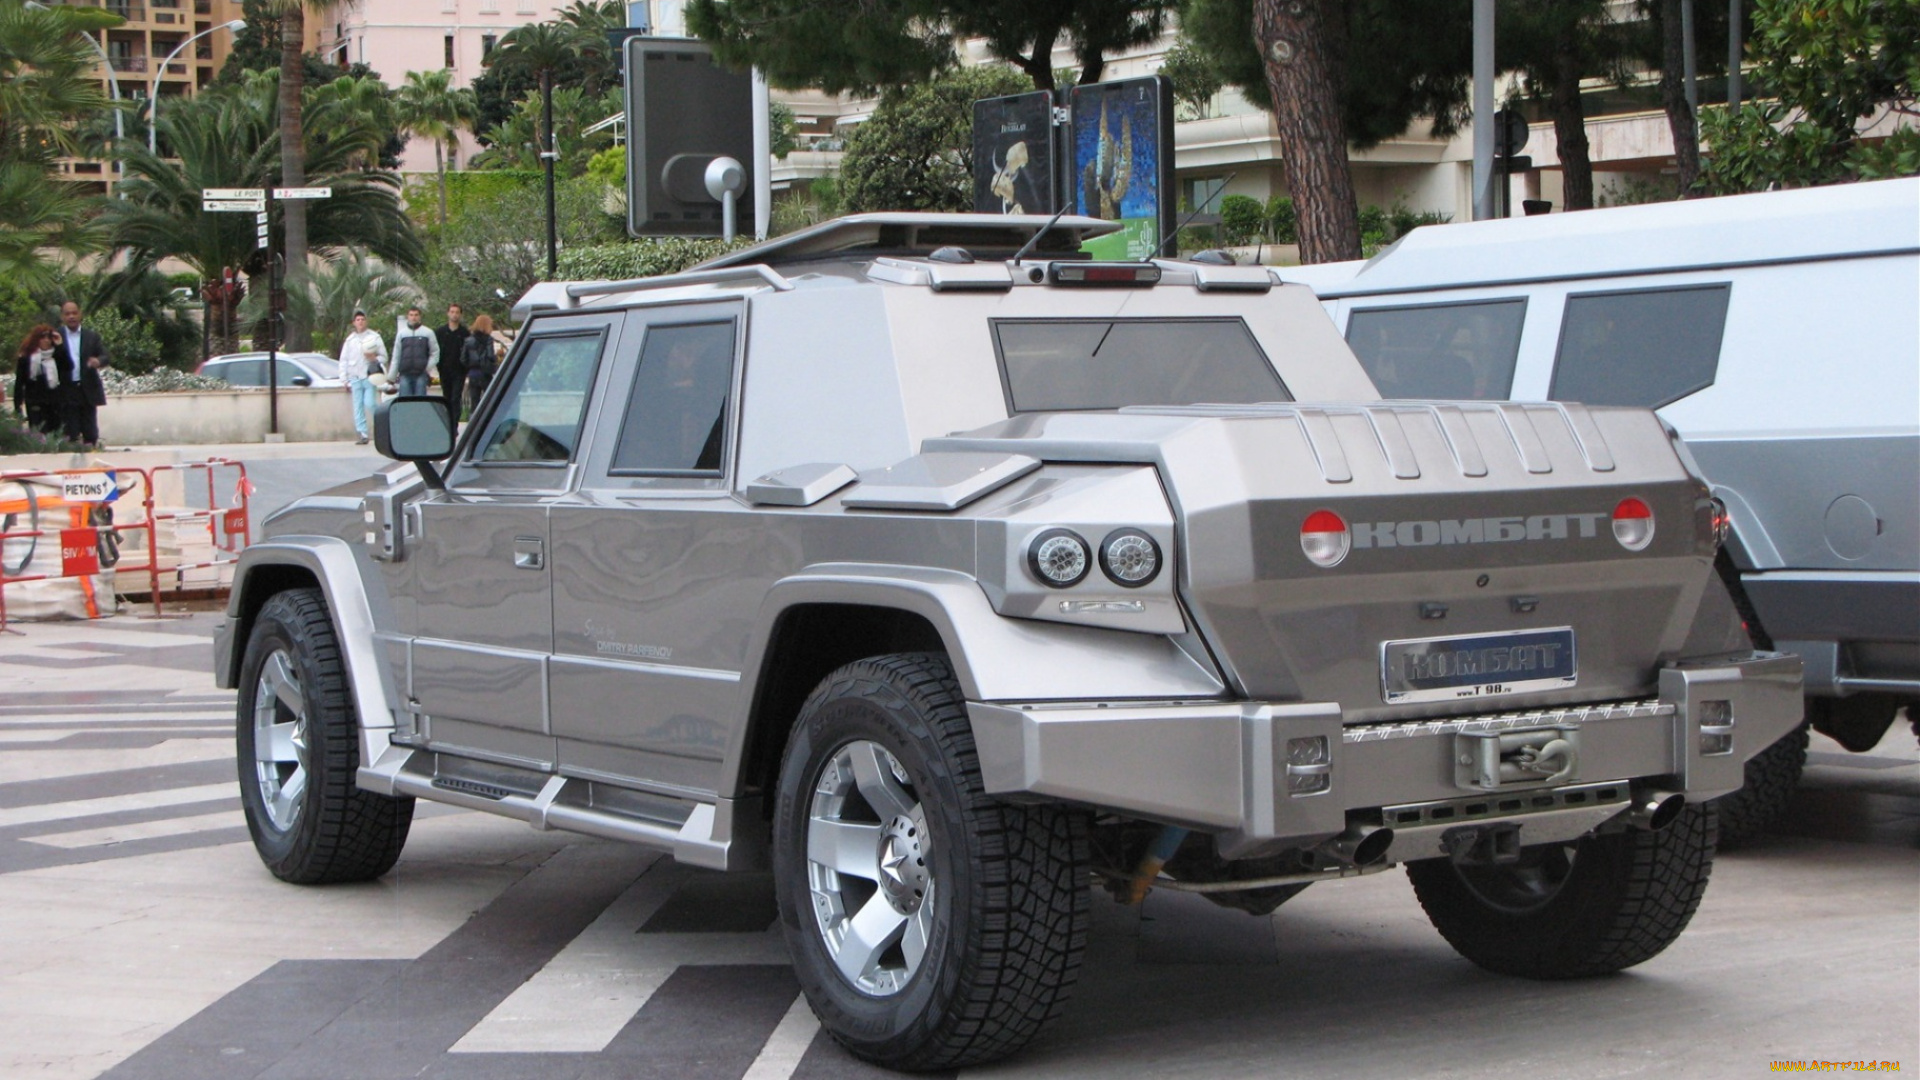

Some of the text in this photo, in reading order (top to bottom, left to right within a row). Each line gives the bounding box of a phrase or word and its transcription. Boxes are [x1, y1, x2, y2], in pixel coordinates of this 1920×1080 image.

[234, 190, 263, 198] LE PORT
[65, 484, 101, 496] PIETONS
[1351, 512, 1608, 549] КОМБАТ
[596, 641, 626, 655] DMITRY
[1402, 643, 1562, 681] КОМБАТ
